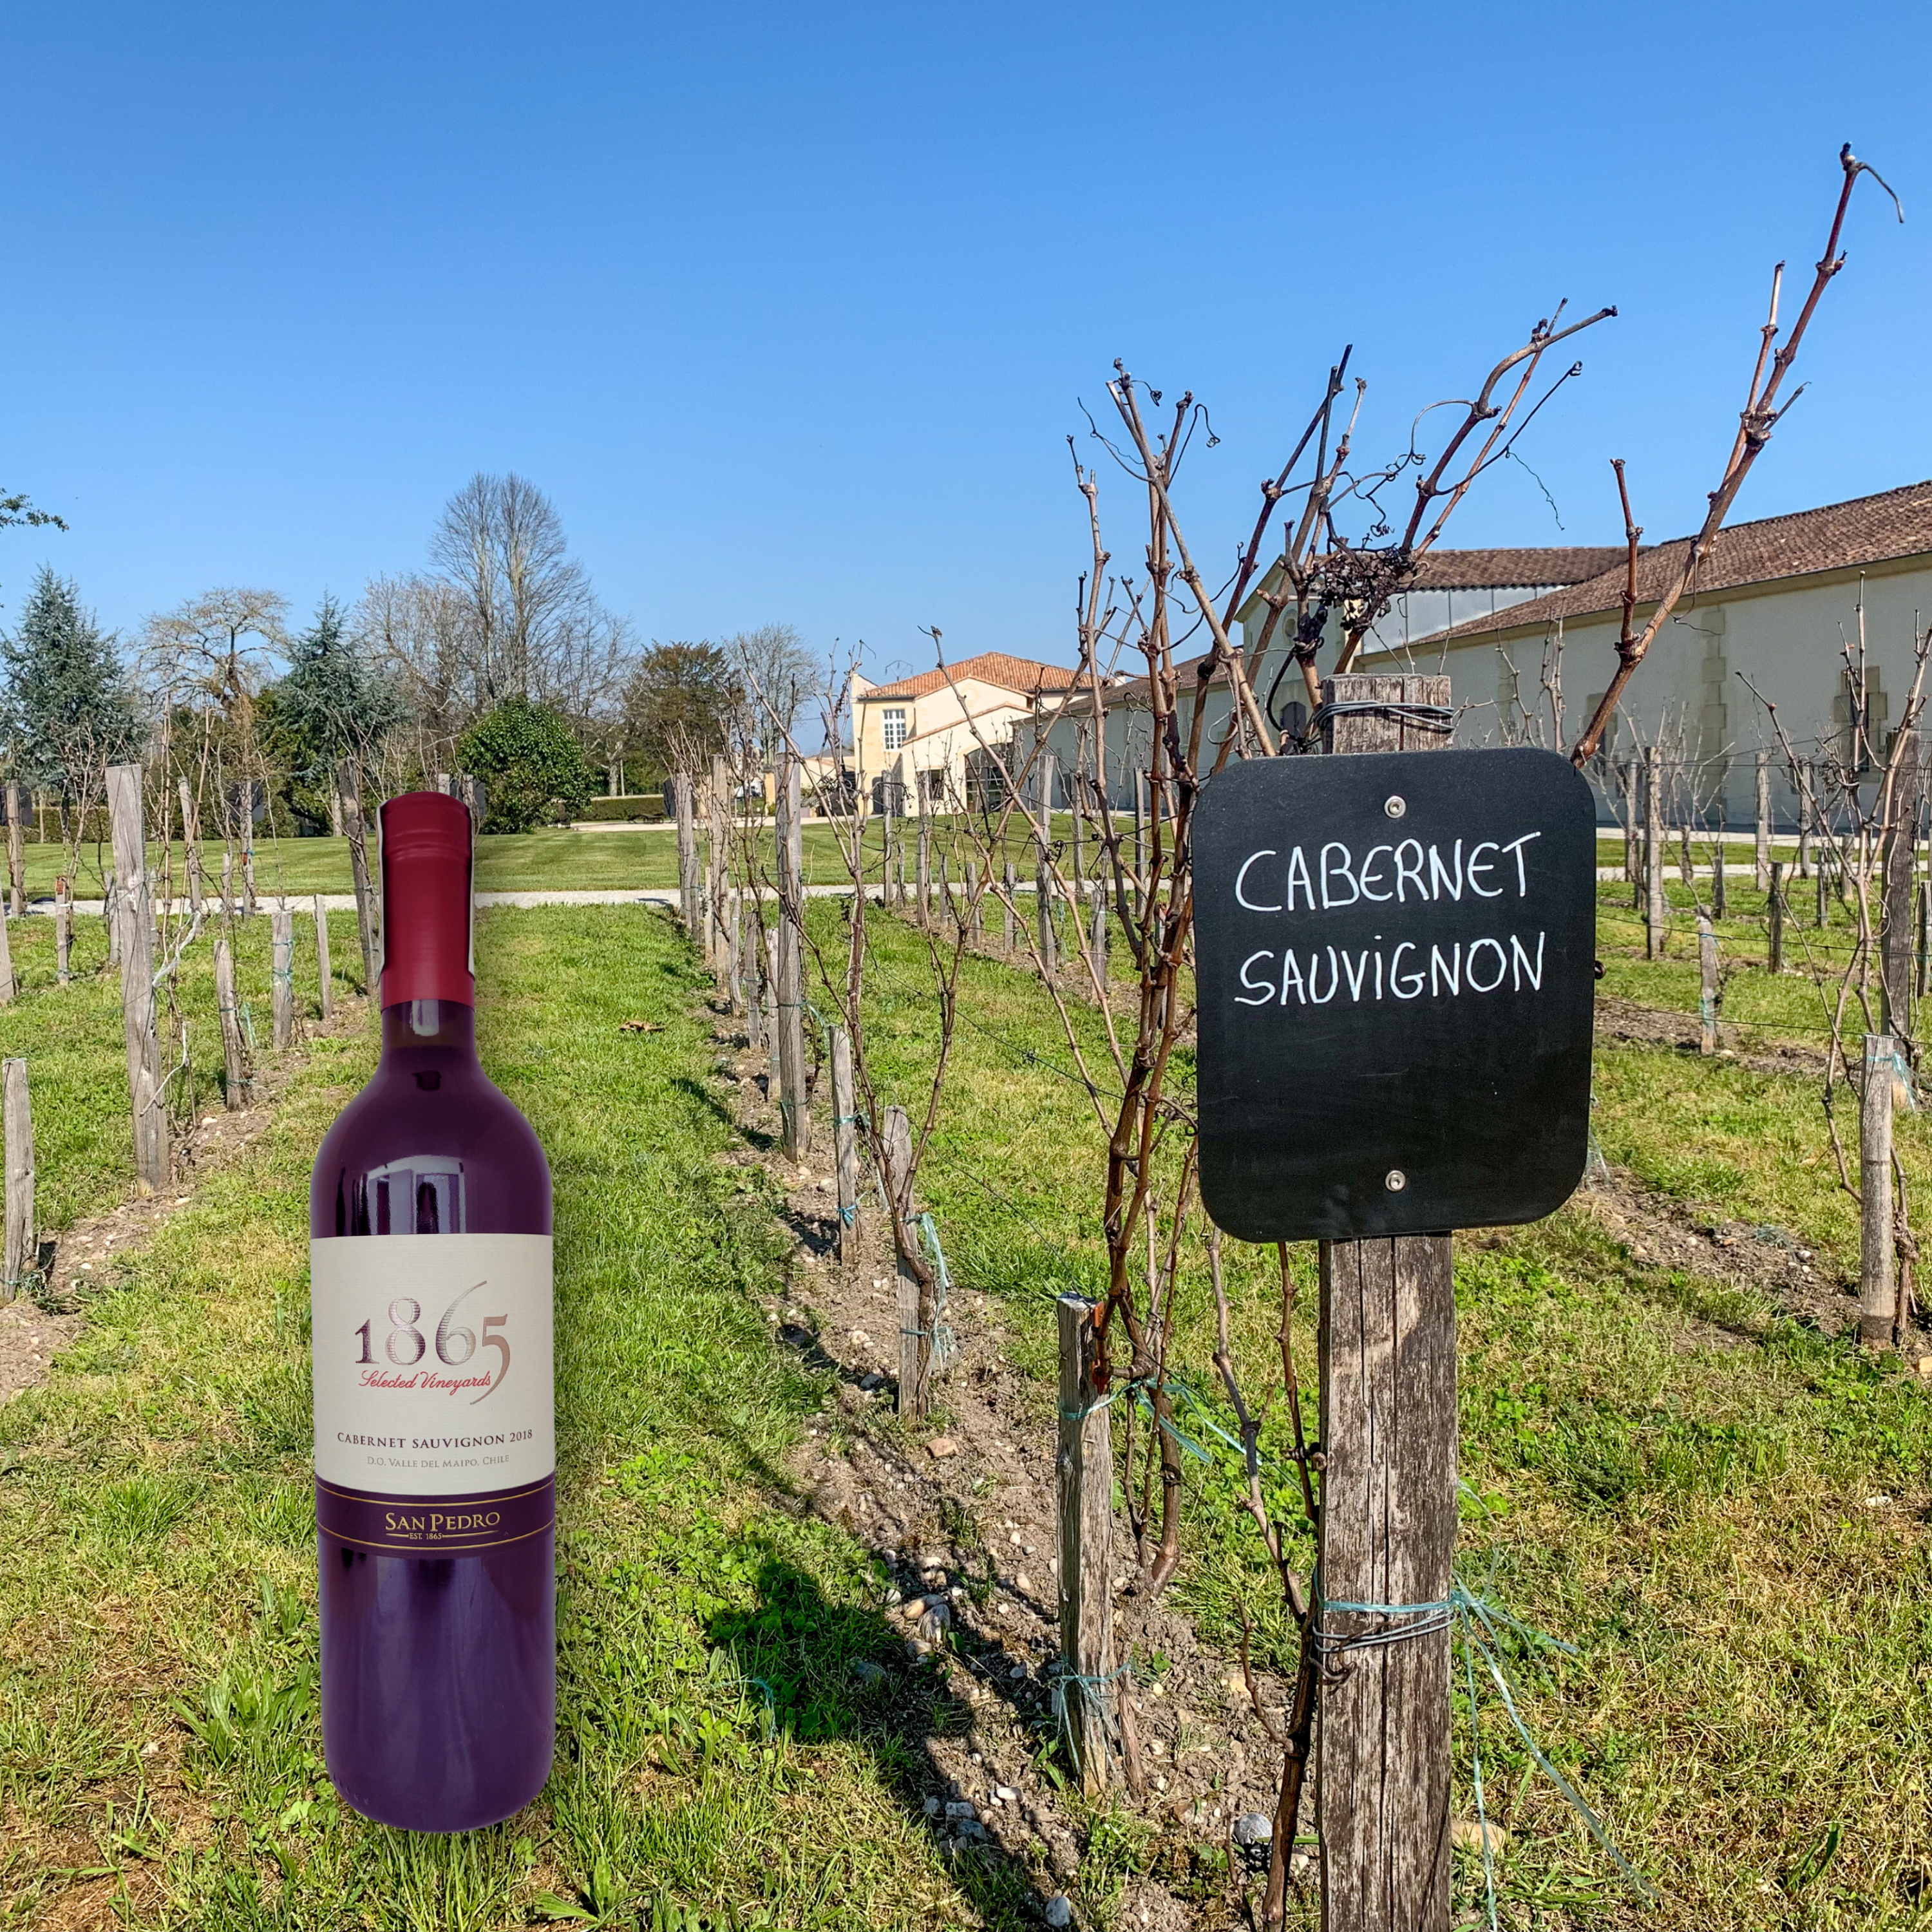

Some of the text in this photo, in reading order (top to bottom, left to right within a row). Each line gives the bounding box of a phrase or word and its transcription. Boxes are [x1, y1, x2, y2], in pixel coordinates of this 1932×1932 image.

[1235, 831, 1541, 911] CABERNET
[354, 1280, 511, 1405] 1865
[358, 1370, 491, 1396] Selected Vineyards
[337, 1428, 533, 1449] CABERNET SAUVIGNON 2018
[367, 1455, 386, 1466] D.O.
[388, 1457, 418, 1468] VALLE
[482, 1454, 510, 1465] CHILE
[385, 1511, 501, 1532] SAN PEDRO
